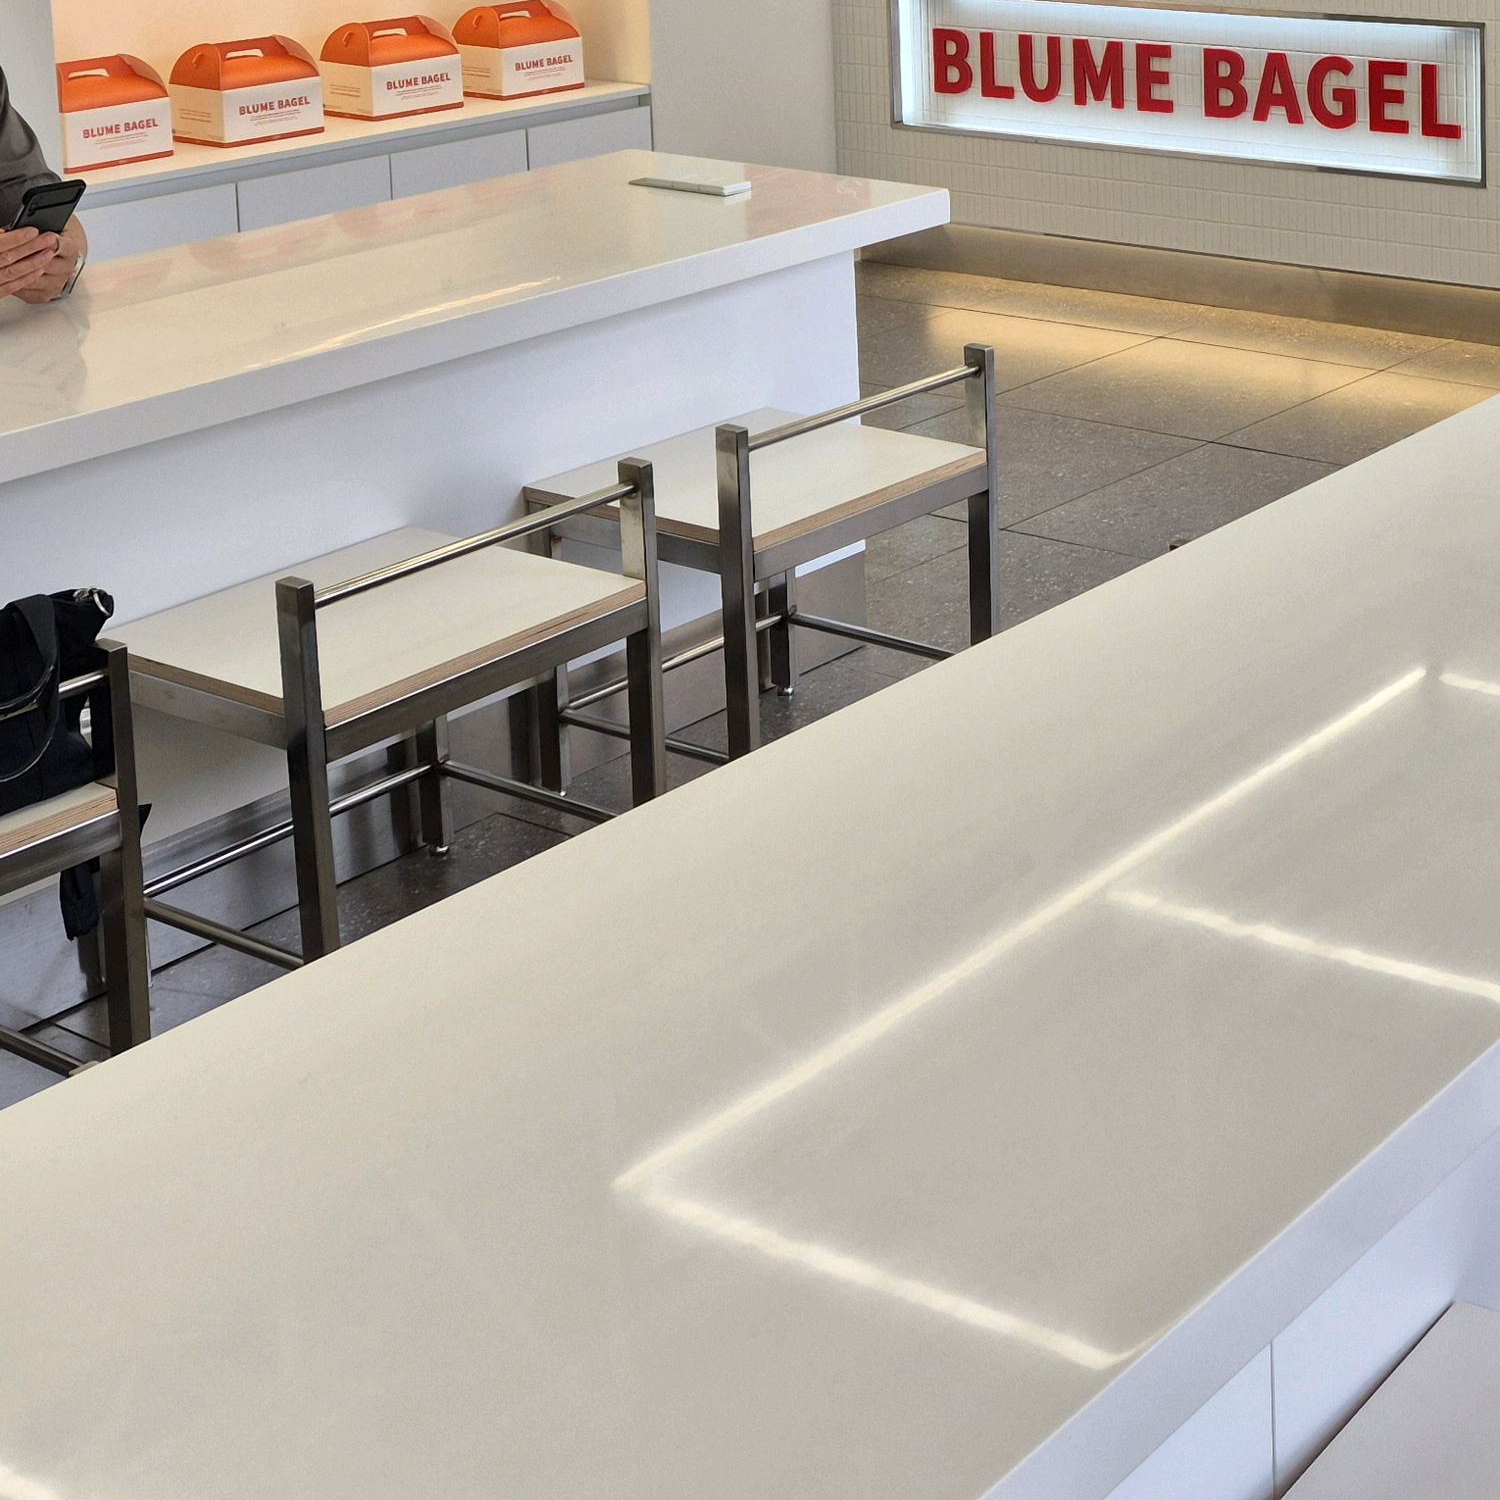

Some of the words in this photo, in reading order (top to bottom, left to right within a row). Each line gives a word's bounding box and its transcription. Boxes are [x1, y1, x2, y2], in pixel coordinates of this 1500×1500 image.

[515, 59, 543, 72] BLUME
[546, 54, 573, 67] BAGEL
[386, 77, 419, 90] BLUME
[422, 73, 451, 85] BAGEL
[932, 27, 1175, 114] BLUME
[1202, 45, 1462, 140] BAGEL
[239, 102, 275, 116] BLUME
[278, 96, 310, 109] BAGEL
[83, 123, 120, 139] BLUME
[124, 118, 158, 132] BAGEL
